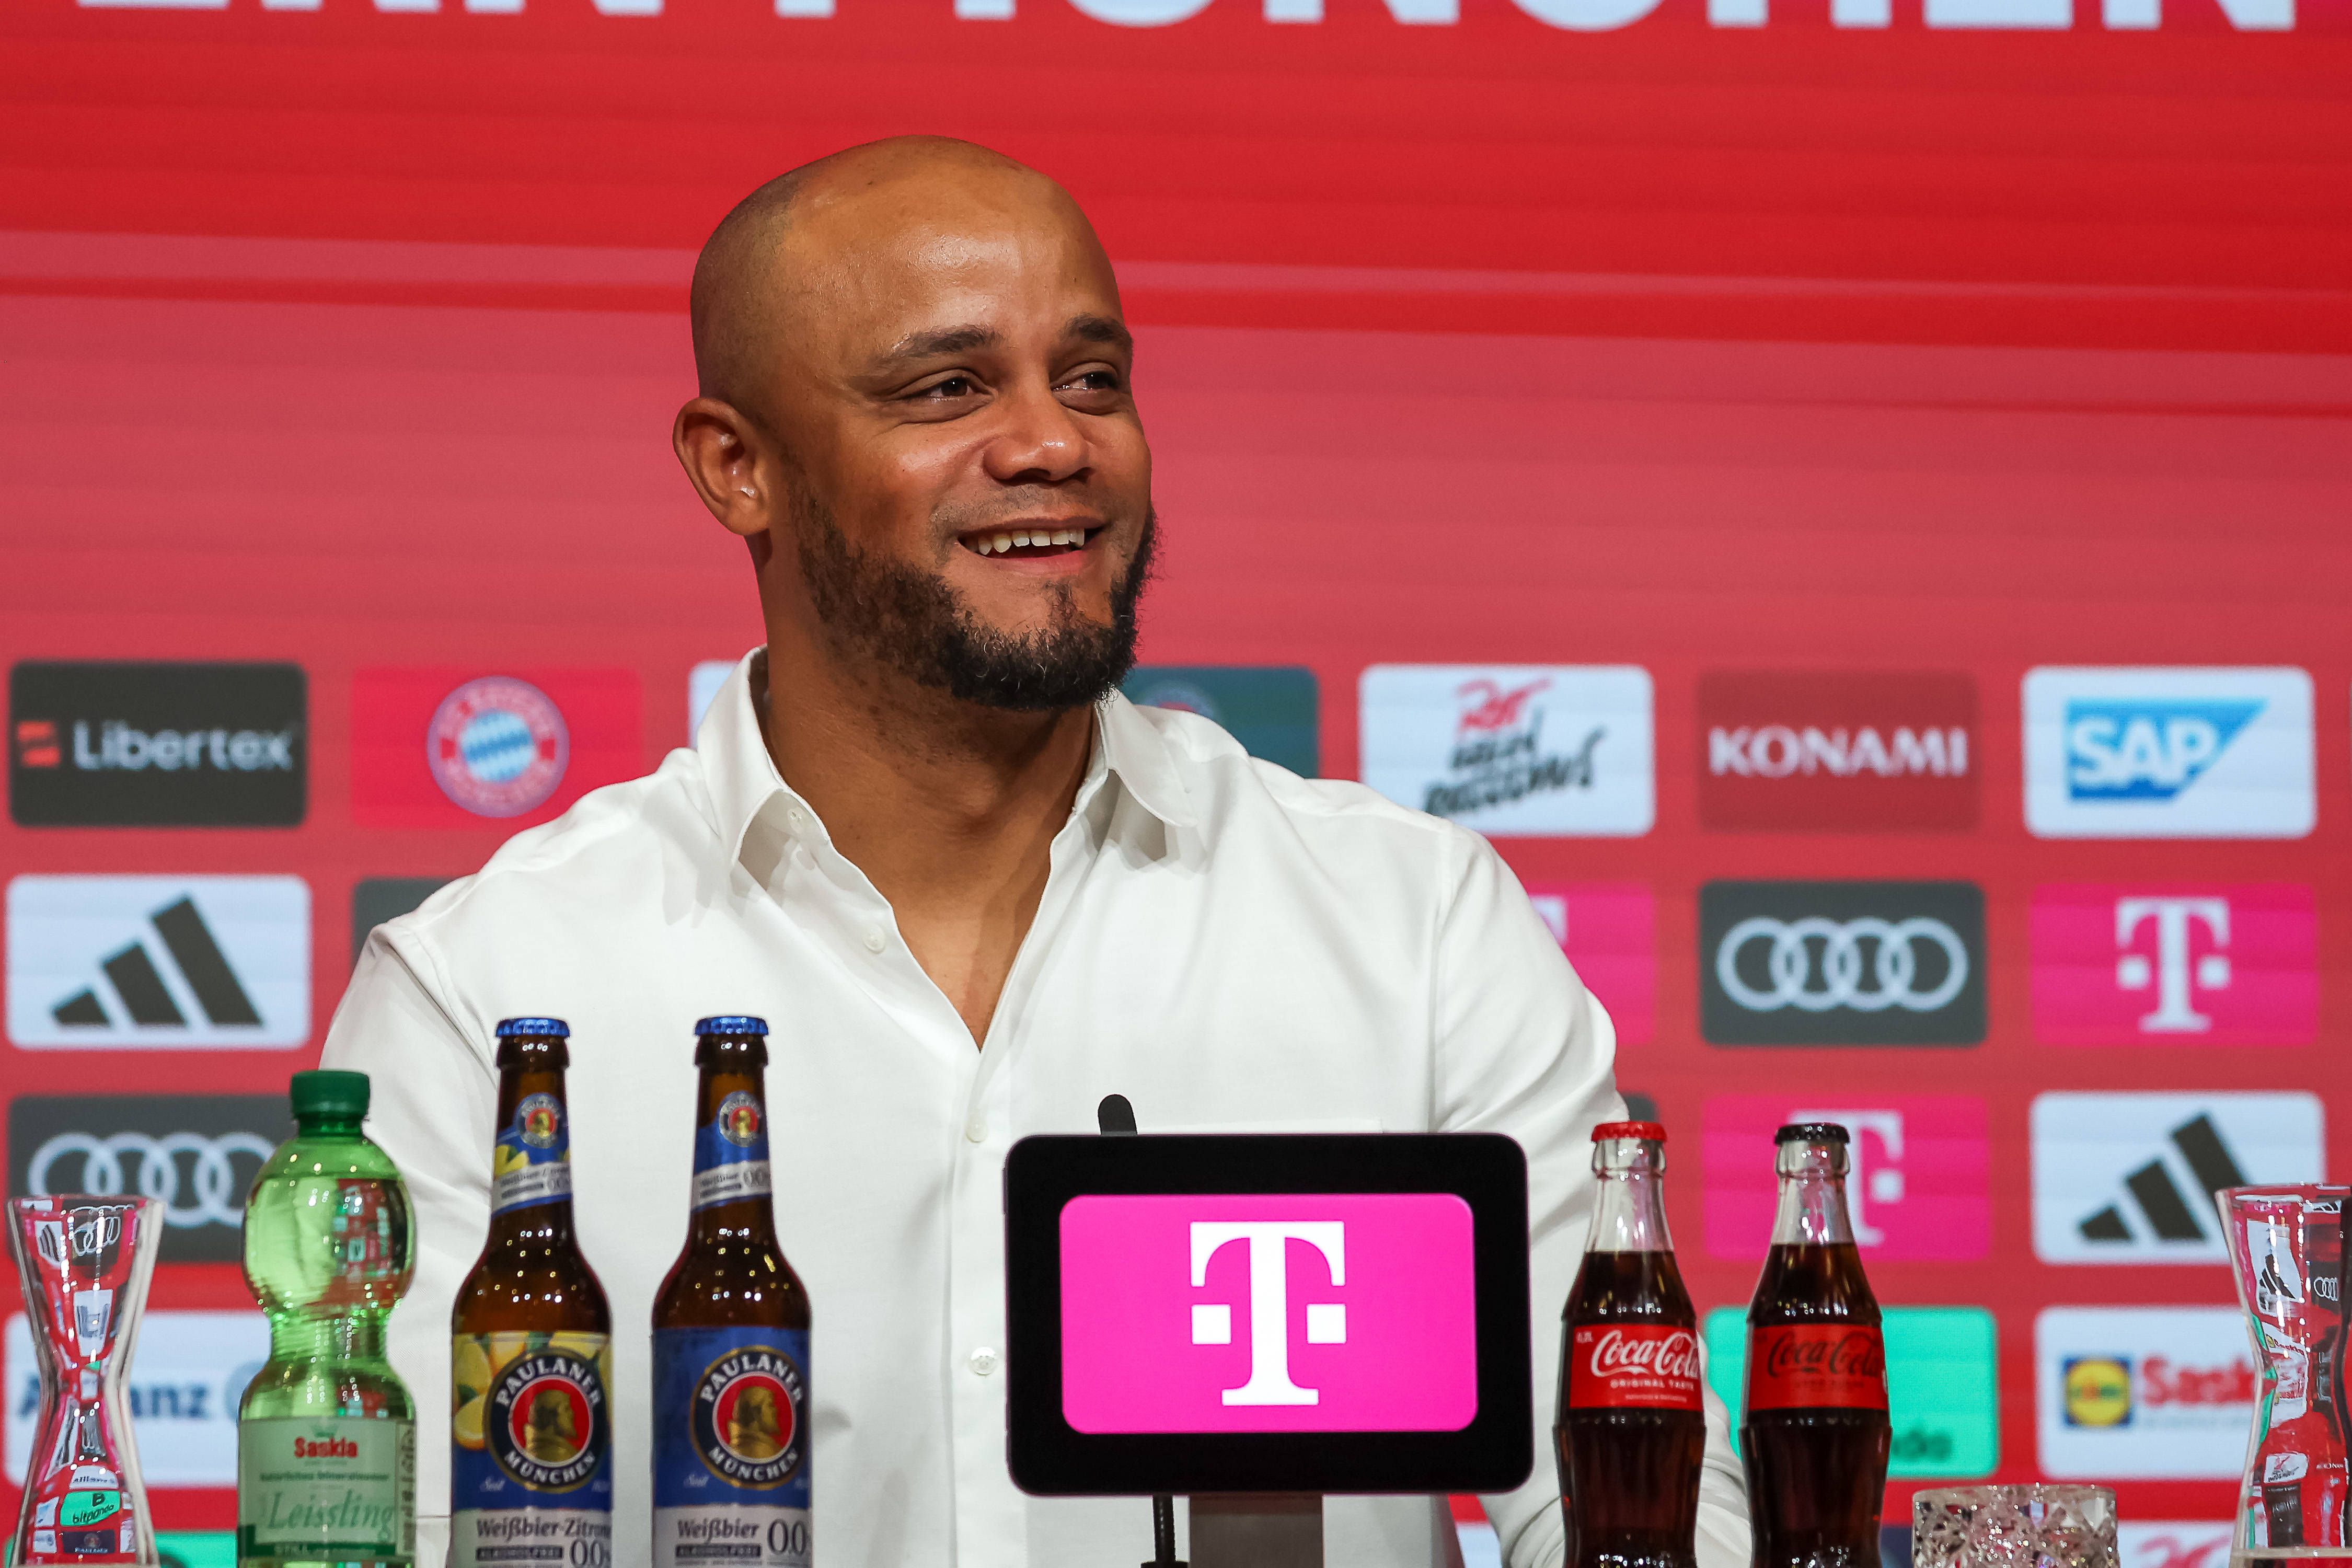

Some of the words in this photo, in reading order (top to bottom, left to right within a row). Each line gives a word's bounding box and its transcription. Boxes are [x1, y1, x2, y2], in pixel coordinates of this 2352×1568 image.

[72, 719, 293, 773] Libertex
[1707, 724, 1969, 778] KONAMI
[2073, 718, 2216, 785] SAP
[1189, 1220, 1347, 1407] T
[496, 1357, 601, 1406] PAULANER
[700, 1353, 804, 1403] PAULANER
[294, 1436, 359, 1459] Saskia
[677, 1517, 760, 1543] Weißbier
